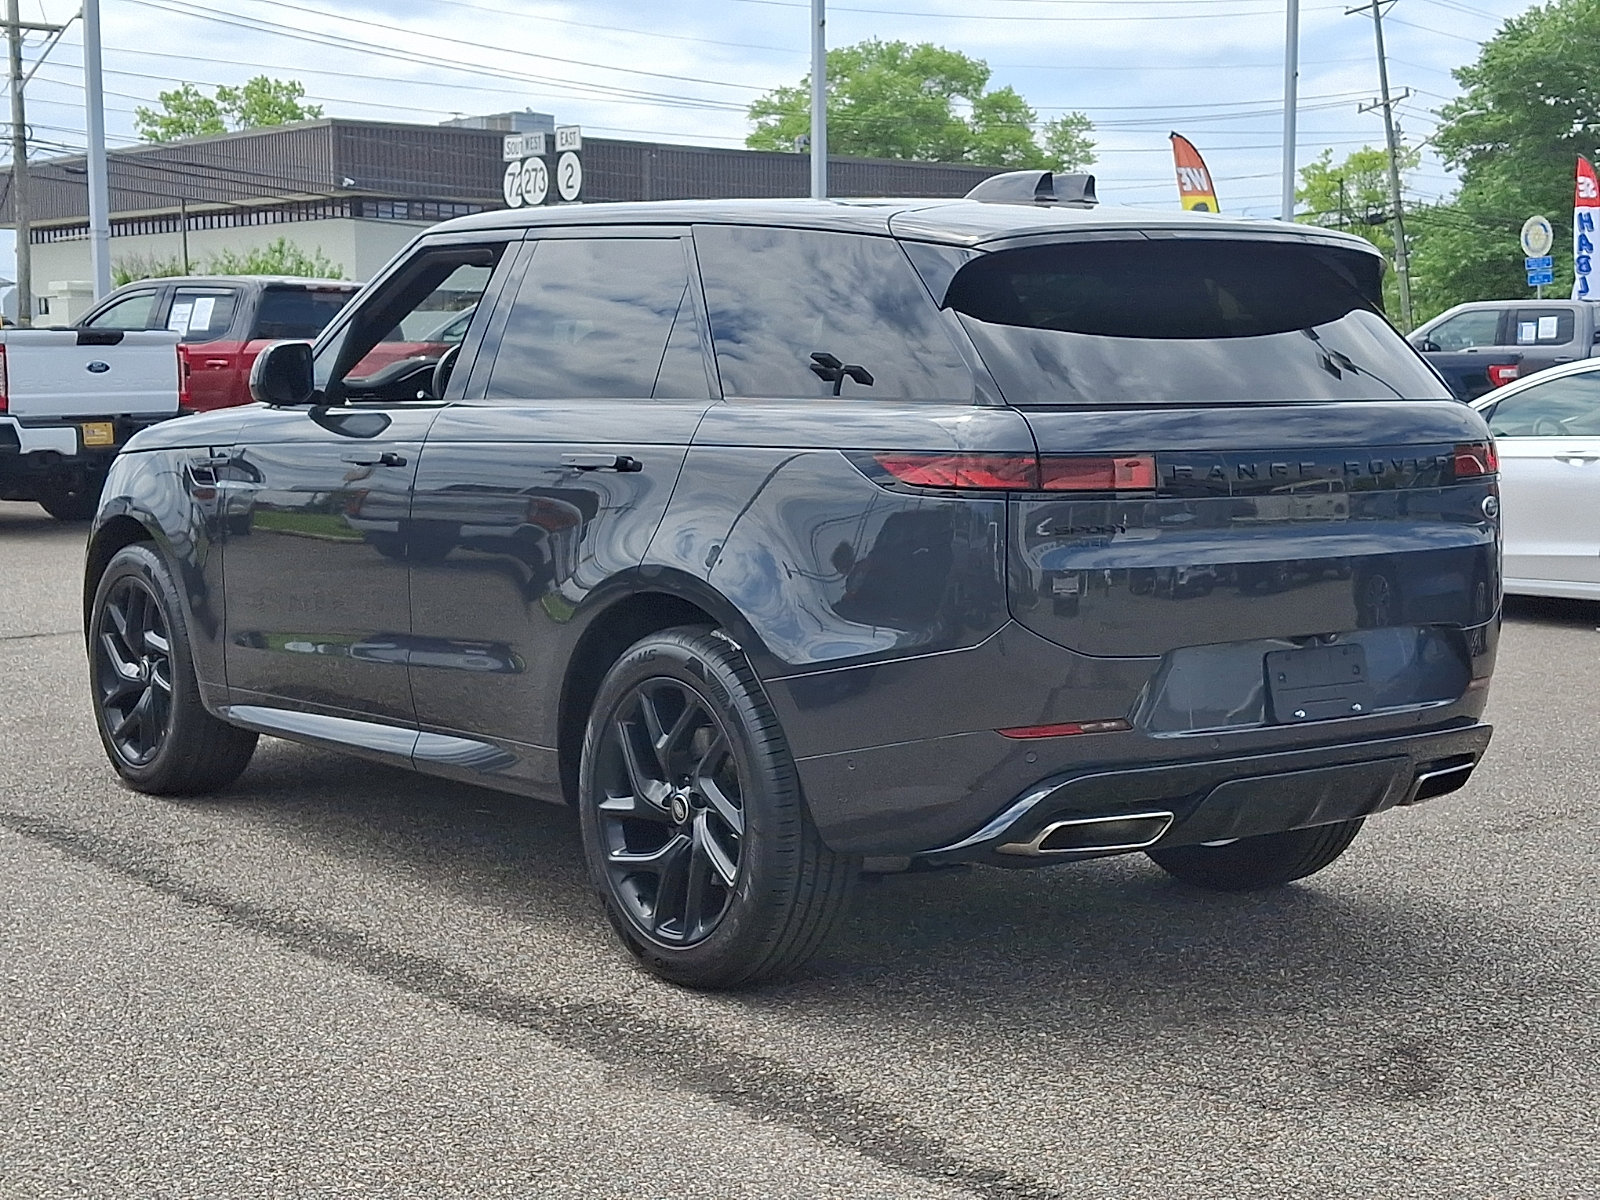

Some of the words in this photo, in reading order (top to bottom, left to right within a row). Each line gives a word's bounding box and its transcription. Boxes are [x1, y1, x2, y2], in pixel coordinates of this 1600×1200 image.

[525, 136, 541, 150] WEST
[560, 131, 577, 147] EAST
[506, 141, 522, 155] SOUT
[523, 167, 545, 193] 273
[565, 163, 574, 189] 2
